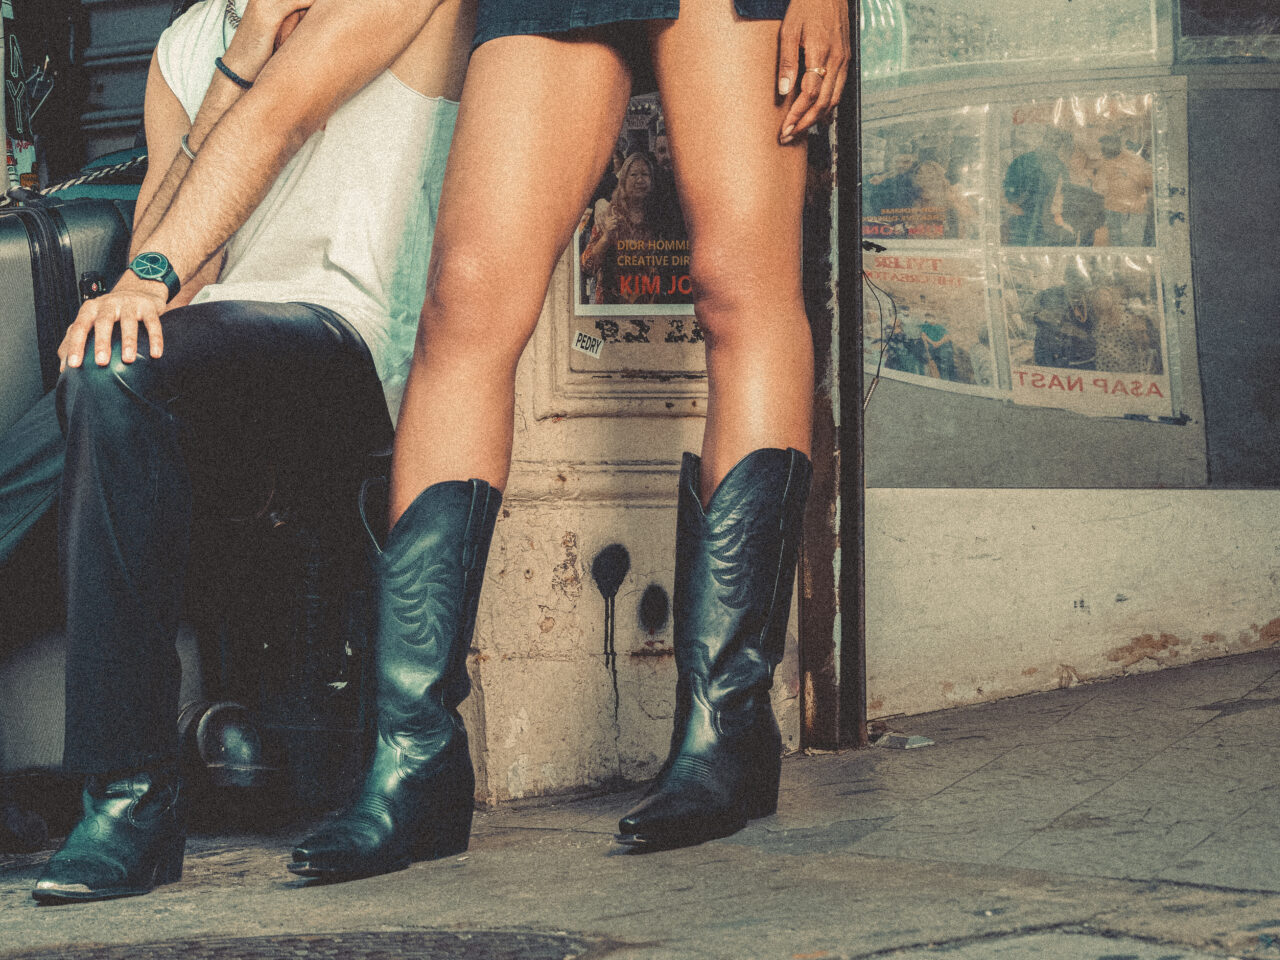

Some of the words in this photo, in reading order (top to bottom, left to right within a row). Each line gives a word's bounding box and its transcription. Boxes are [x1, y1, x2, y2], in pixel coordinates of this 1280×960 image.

[617, 240, 645, 251] DIOR
[617, 254, 669, 267] CREATIVE
[620, 275, 661, 296] KIM
[575, 332, 602, 355] PEDRY
